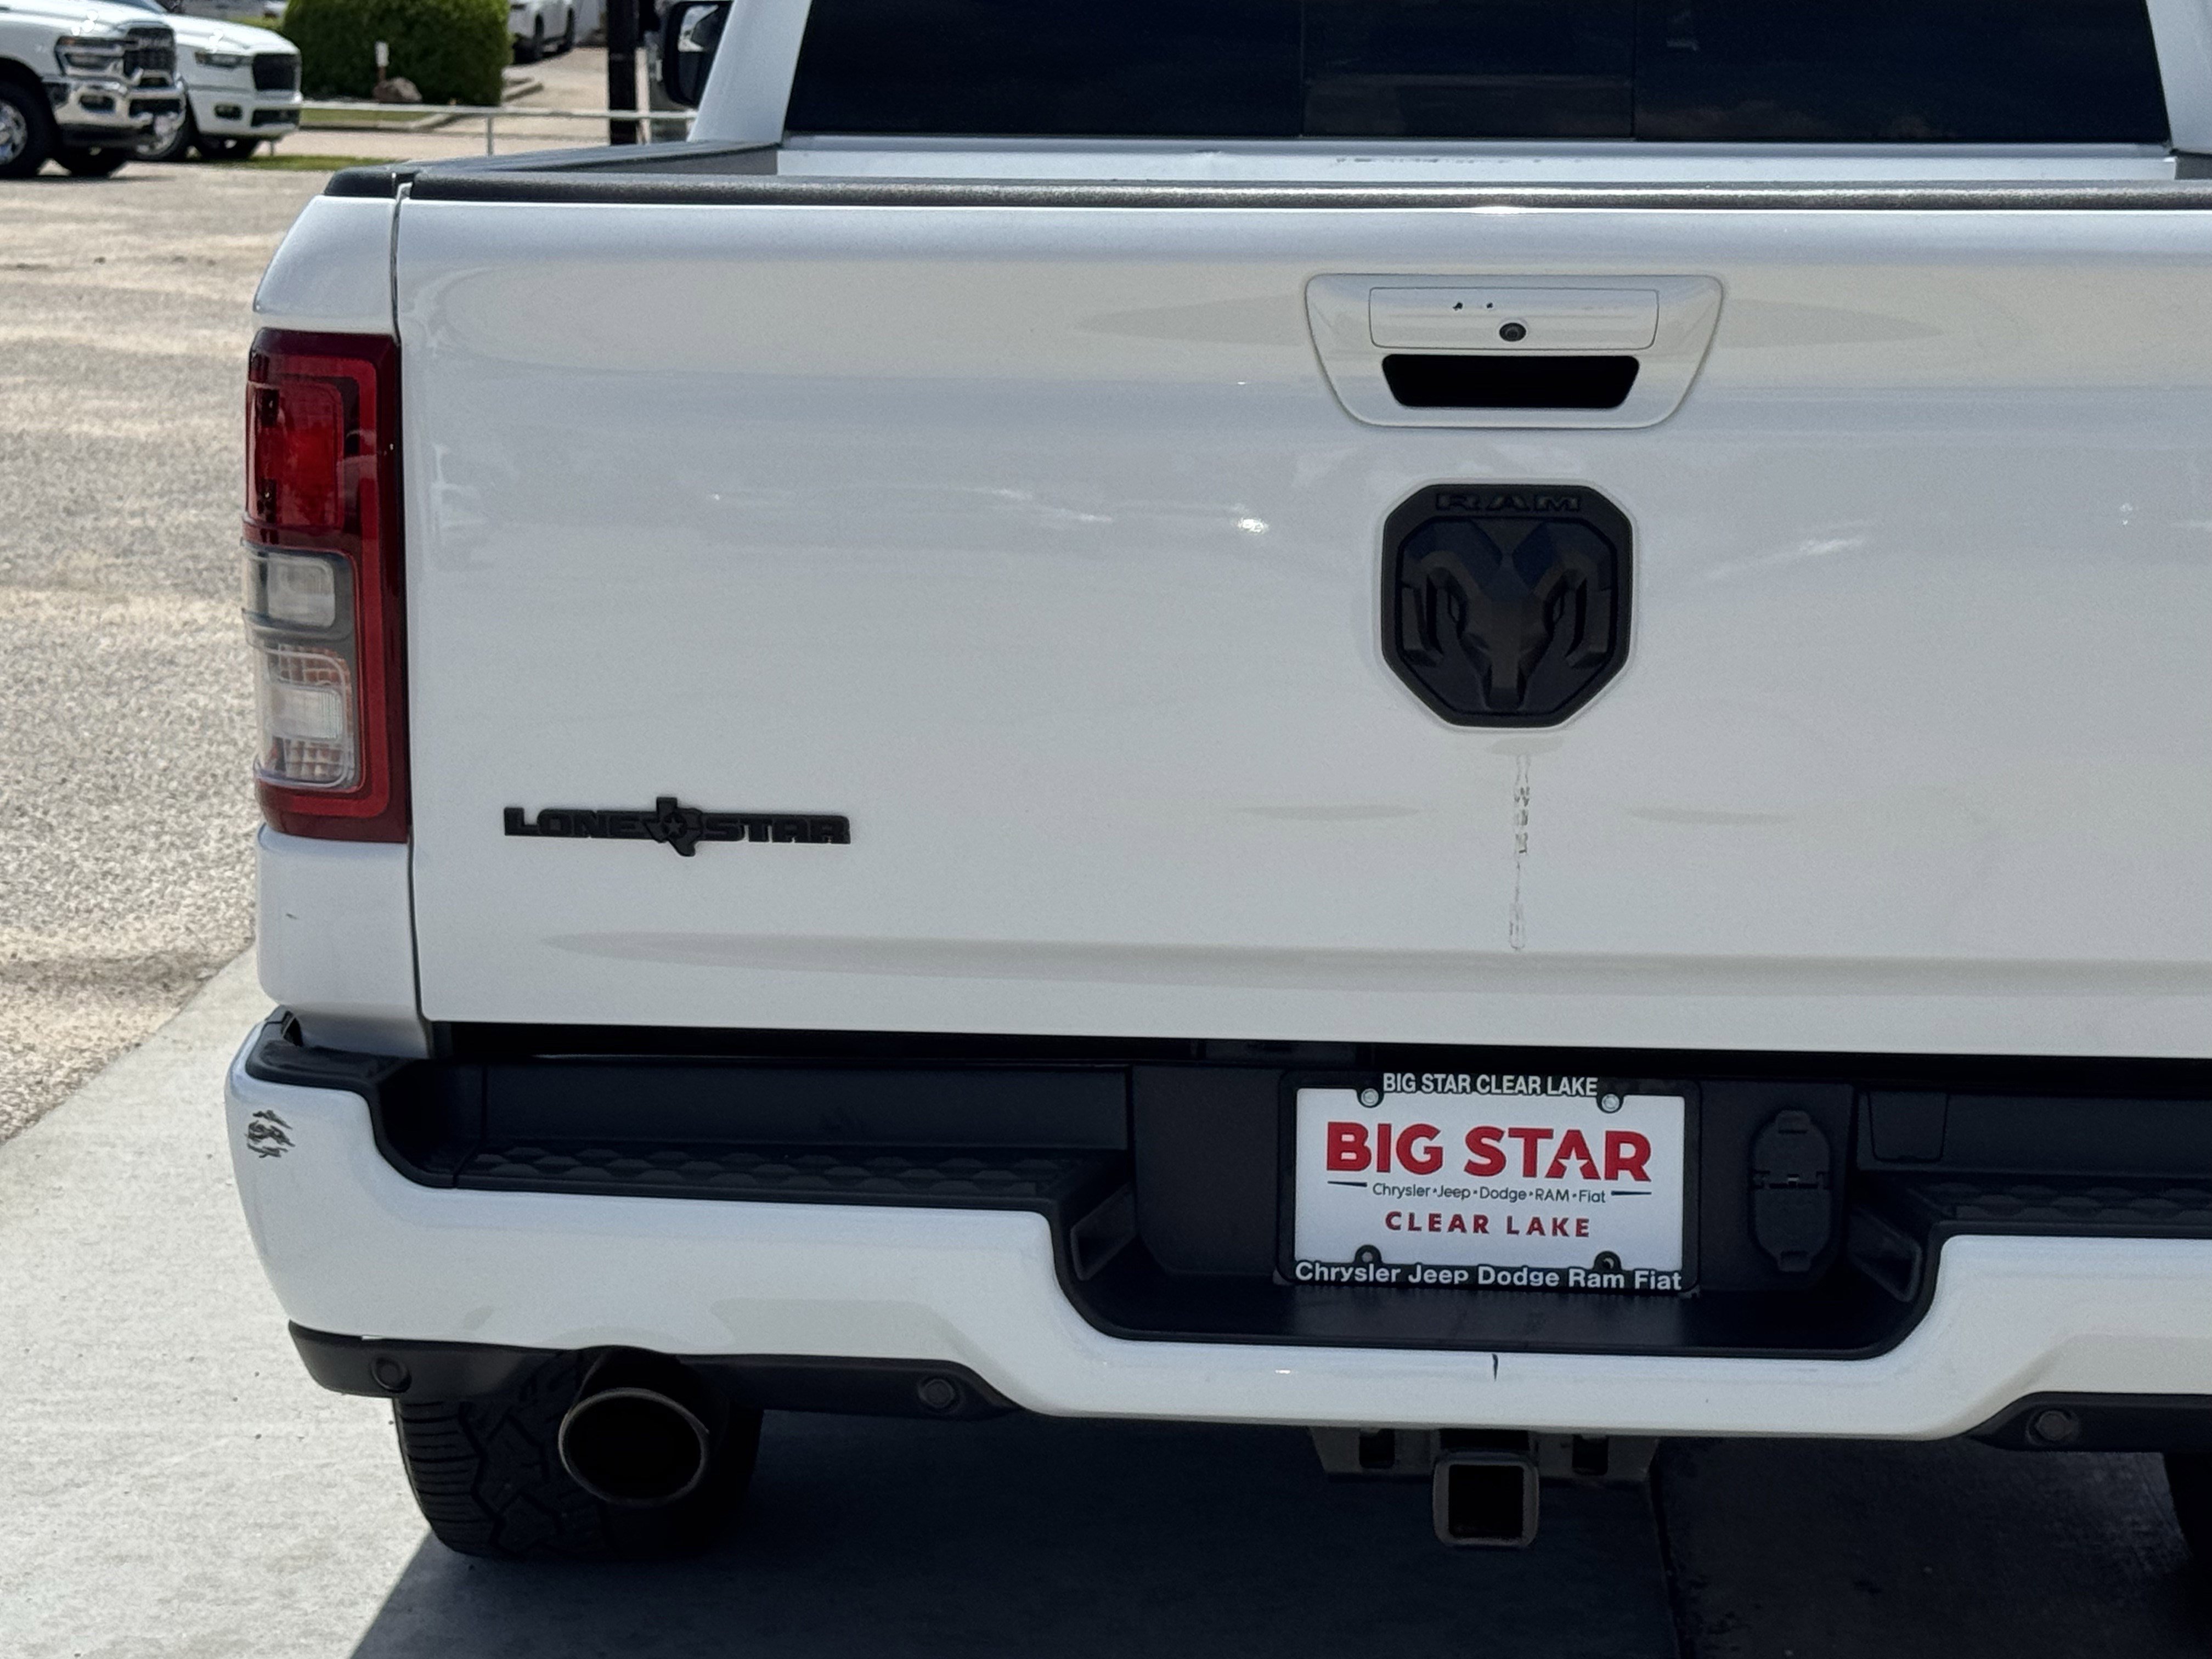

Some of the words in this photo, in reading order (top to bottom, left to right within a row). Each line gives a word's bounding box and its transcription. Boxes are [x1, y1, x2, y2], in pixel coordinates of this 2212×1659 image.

[1435, 494, 1581, 511] RAM
[504, 807, 657, 839] LONE
[701, 813, 851, 844] STAR
[1383, 1073, 1415, 1092] BIG
[1421, 1074, 1471, 1093] STAR
[1476, 1075, 1541, 1095] CLEAR
[1547, 1077, 1598, 1096] LAKE
[1327, 1122, 1443, 1175] BIG
[1464, 1126, 1652, 1182] STAR
[1385, 1211, 1489, 1234] CLEAR
[1506, 1216, 1590, 1237] LAKE
[1295, 1262, 1401, 1284] Chrysler
[1408, 1266, 1469, 1285] Jeep
[1478, 1268, 1560, 1288] Dodge
[1568, 1271, 1626, 1289] Ram
[1634, 1271, 1682, 1291] Fiat
